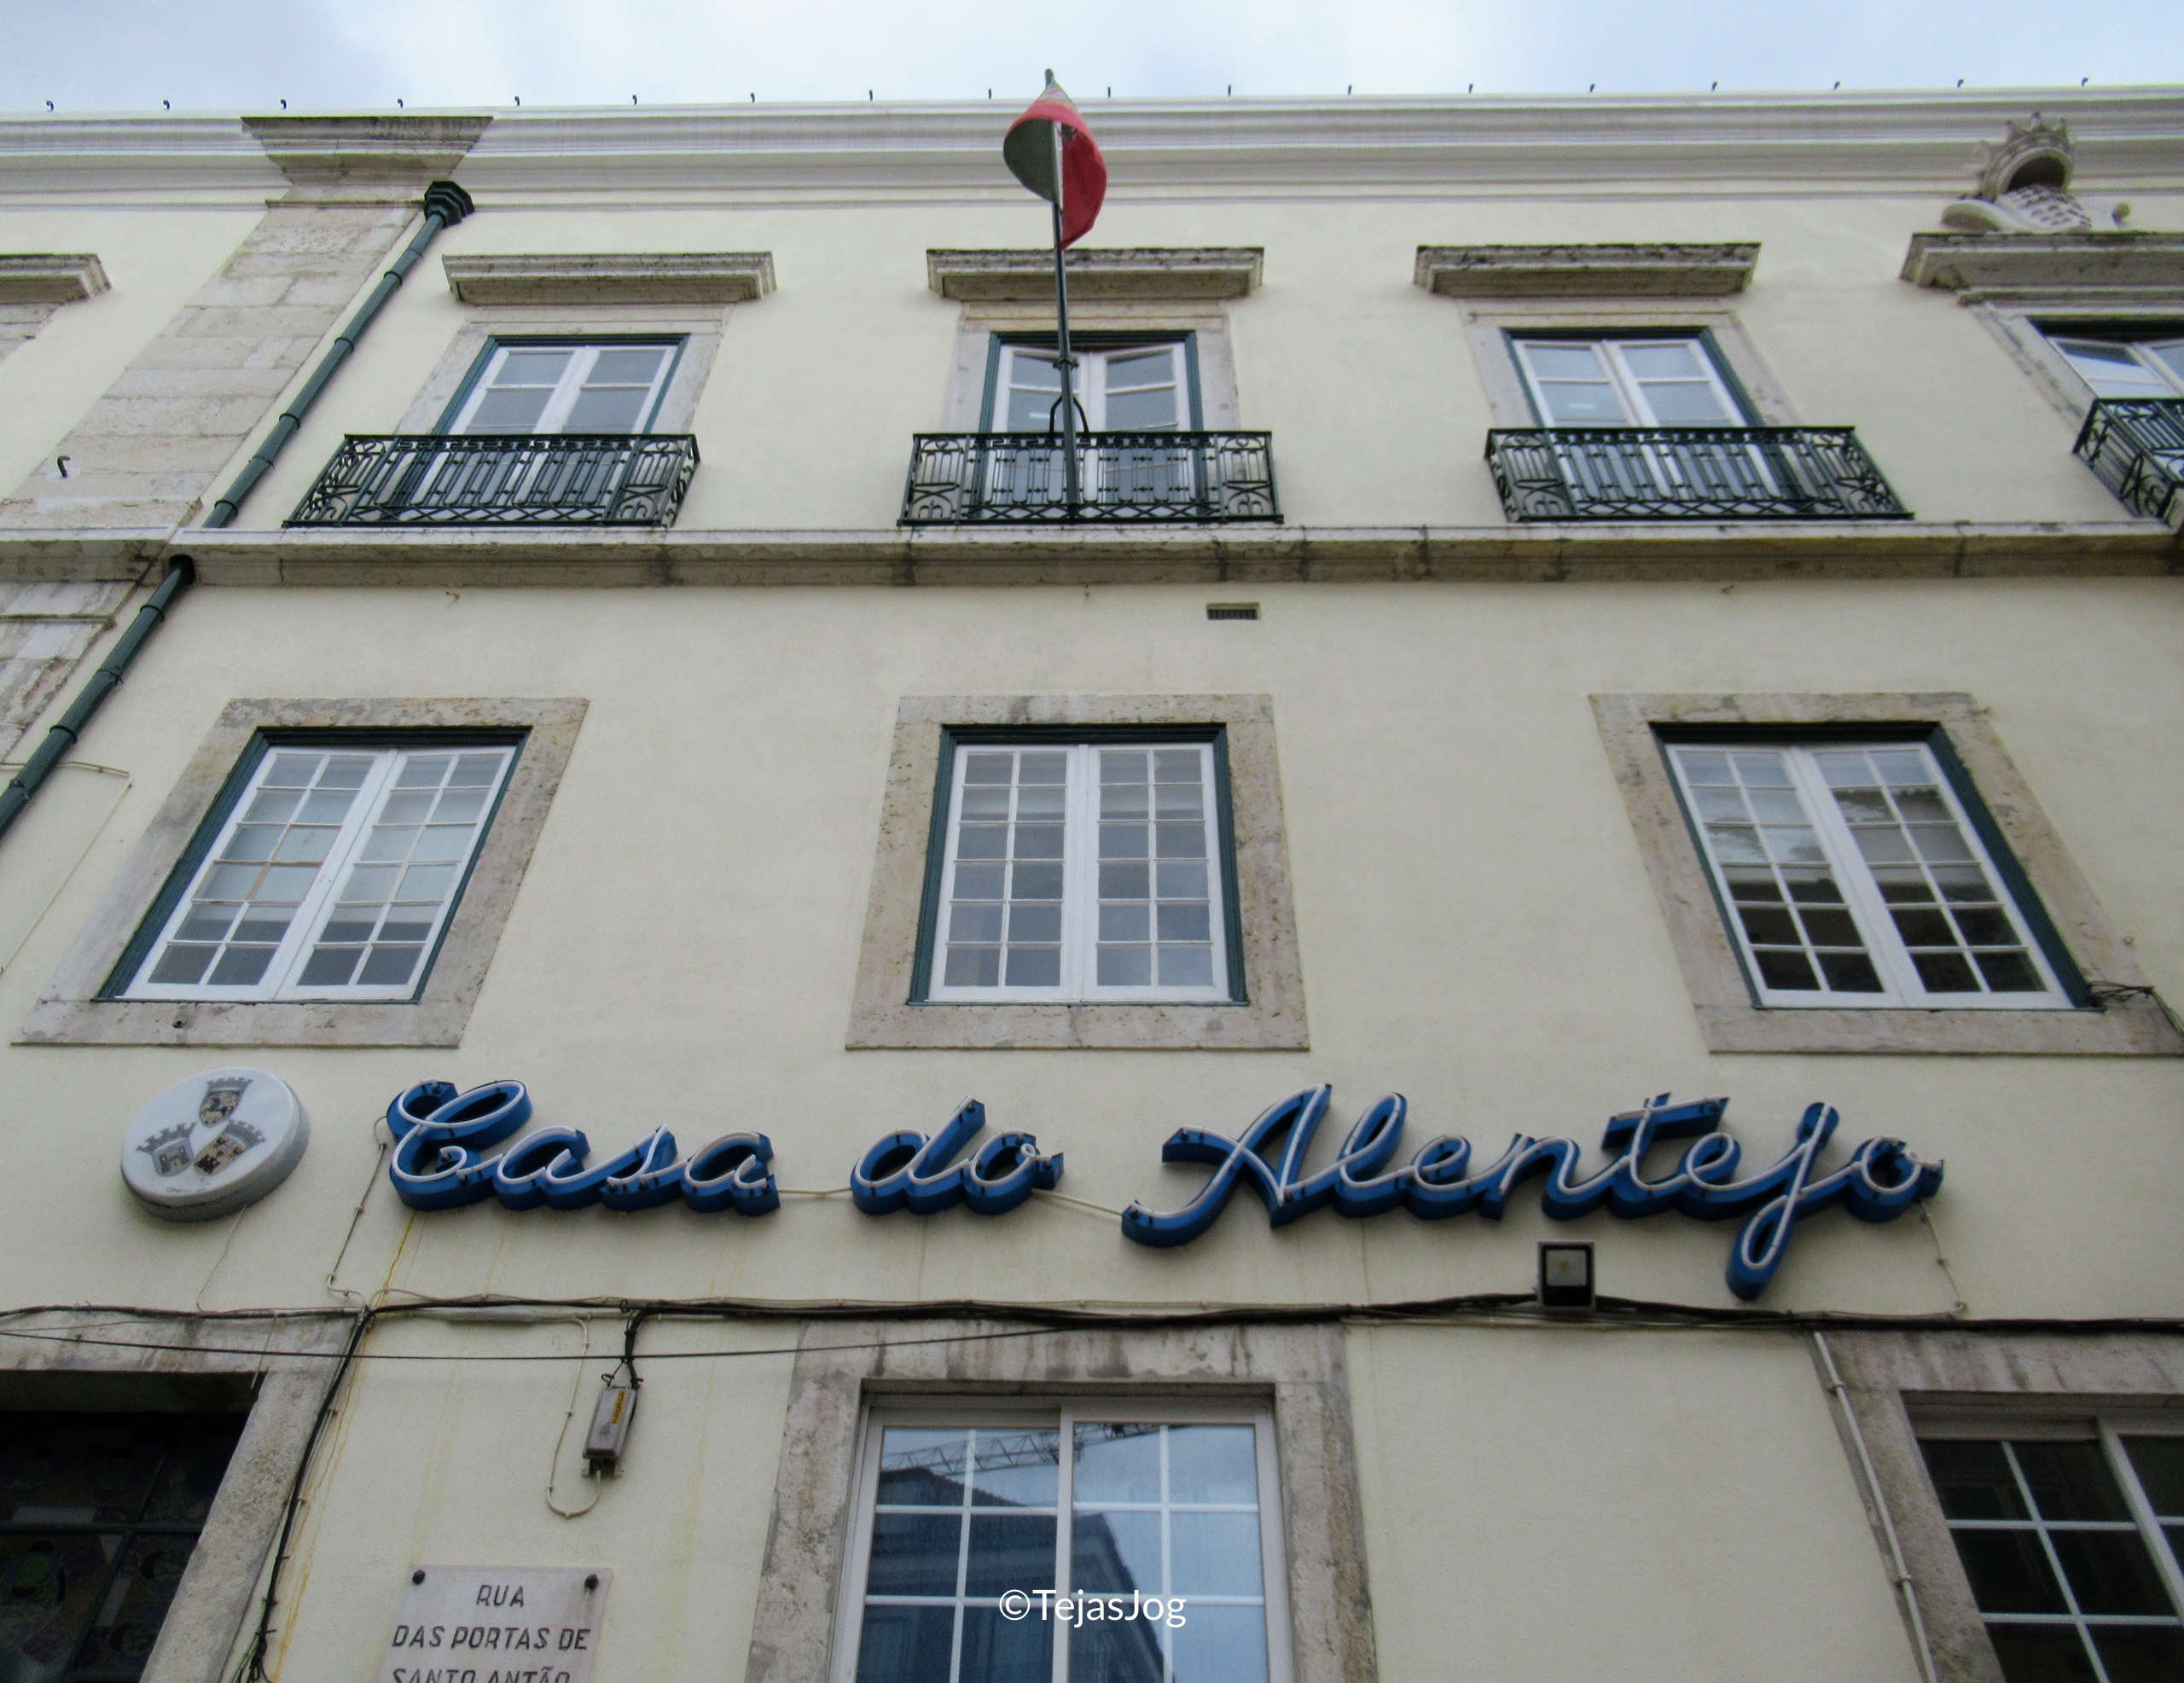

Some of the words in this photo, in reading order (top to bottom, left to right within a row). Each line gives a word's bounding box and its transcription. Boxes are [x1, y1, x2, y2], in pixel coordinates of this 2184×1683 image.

[386, 1079, 781, 1216] Casa
[850, 1094, 1065, 1216] do
[1121, 1082, 1944, 1300] Alentejo
[475, 1584, 525, 1607] RUA
[392, 1625, 445, 1648] DAS
[450, 1626, 549, 1650] PORTAS
[558, 1628, 590, 1651] DE
